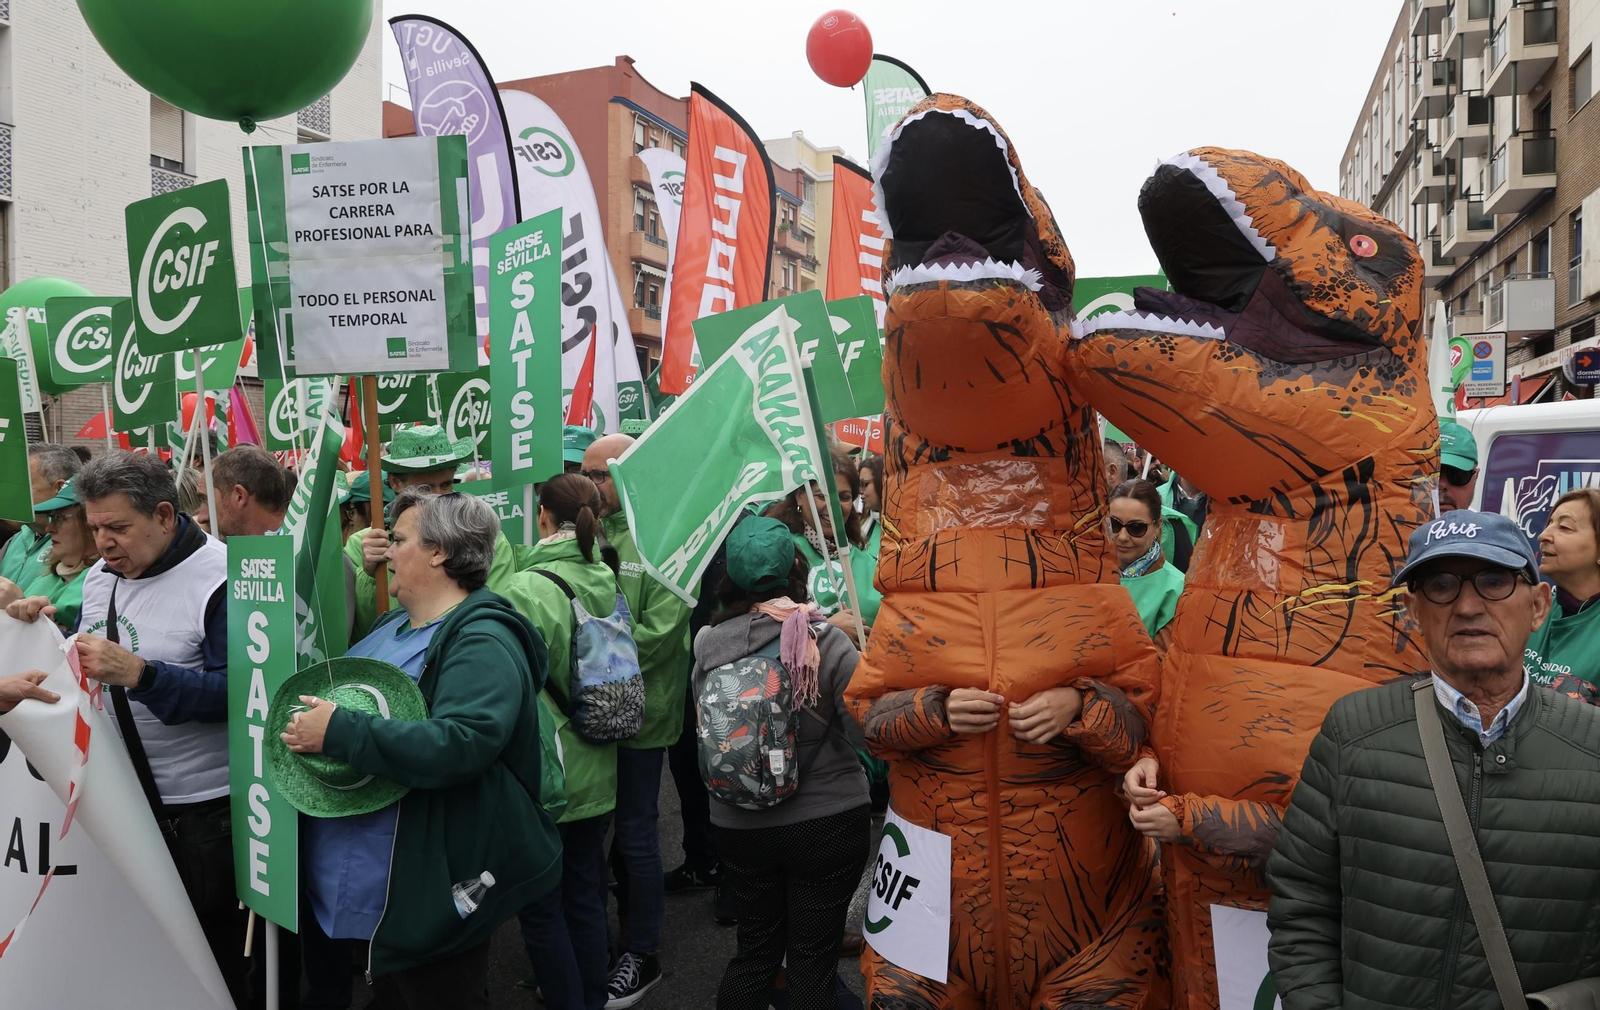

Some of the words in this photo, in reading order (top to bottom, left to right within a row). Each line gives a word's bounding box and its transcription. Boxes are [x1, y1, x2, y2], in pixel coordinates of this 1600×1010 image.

[312, 184, 355, 198] SATSE
[360, 182, 388, 195] POR
[392, 181, 410, 194] LA
[329, 203, 395, 219] CARRERA
[295, 226, 390, 243] PROFESIONAL
[395, 223, 434, 238] PARA
[505, 230, 543, 257] SATSE
[153, 240, 219, 294] CSIF
[497, 242, 552, 276] SEVILLA
[298, 294, 339, 307] TODO
[344, 293, 360, 305] EL
[363, 289, 436, 304] PERSONAL
[329, 312, 408, 327] TEMPORAL
[509, 270, 536, 471] SATSE
[619, 393, 639, 404] CSIF
[1424, 520, 1483, 546] Paris
[241, 558, 276, 579] SATSE
[234, 580, 285, 602] SEVILLA
[246, 610, 272, 897] SATSE
[871, 852, 921, 911] CSIF
